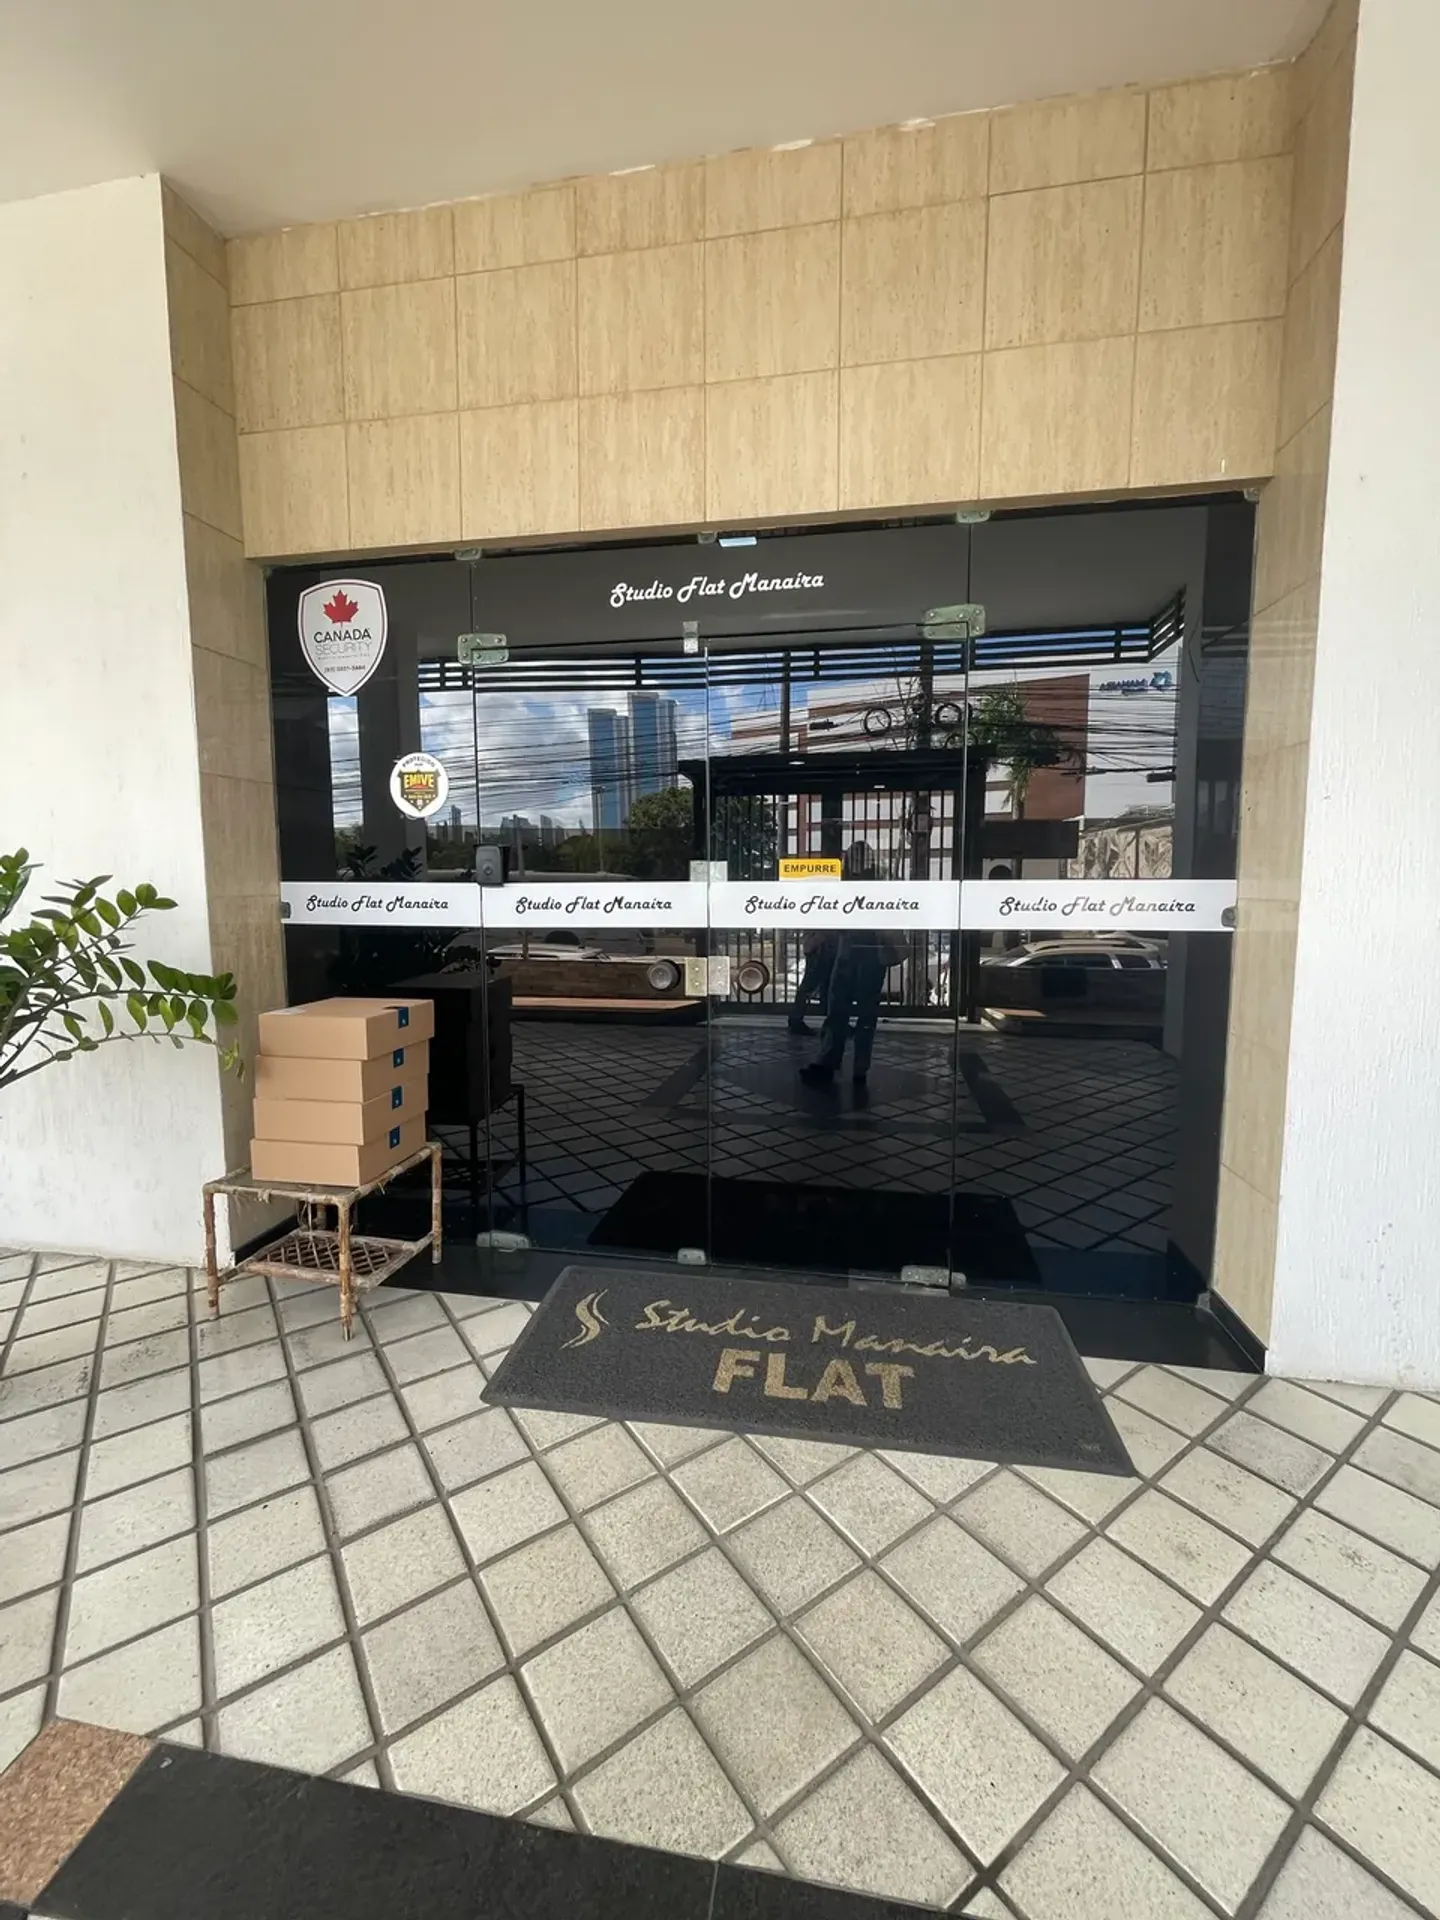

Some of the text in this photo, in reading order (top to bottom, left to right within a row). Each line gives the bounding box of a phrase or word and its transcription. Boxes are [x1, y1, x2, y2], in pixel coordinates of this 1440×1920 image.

[610, 580, 673, 608] Studio
[677, 576, 725, 603] Flat
[313, 628, 372, 643] CANADA
[784, 864, 837, 873] EMPURRE
[306, 895, 348, 911] Studio
[351, 895, 383, 912] Flat
[515, 896, 562, 914] Studio
[565, 896, 600, 914] Flat
[744, 895, 796, 914] Studio
[799, 895, 839, 914] Flat
[999, 896, 1057, 916] Studio
[1061, 896, 1106, 916] Flat
[635, 1299, 791, 1341] Studio
[712, 1348, 915, 1409] FLAT
